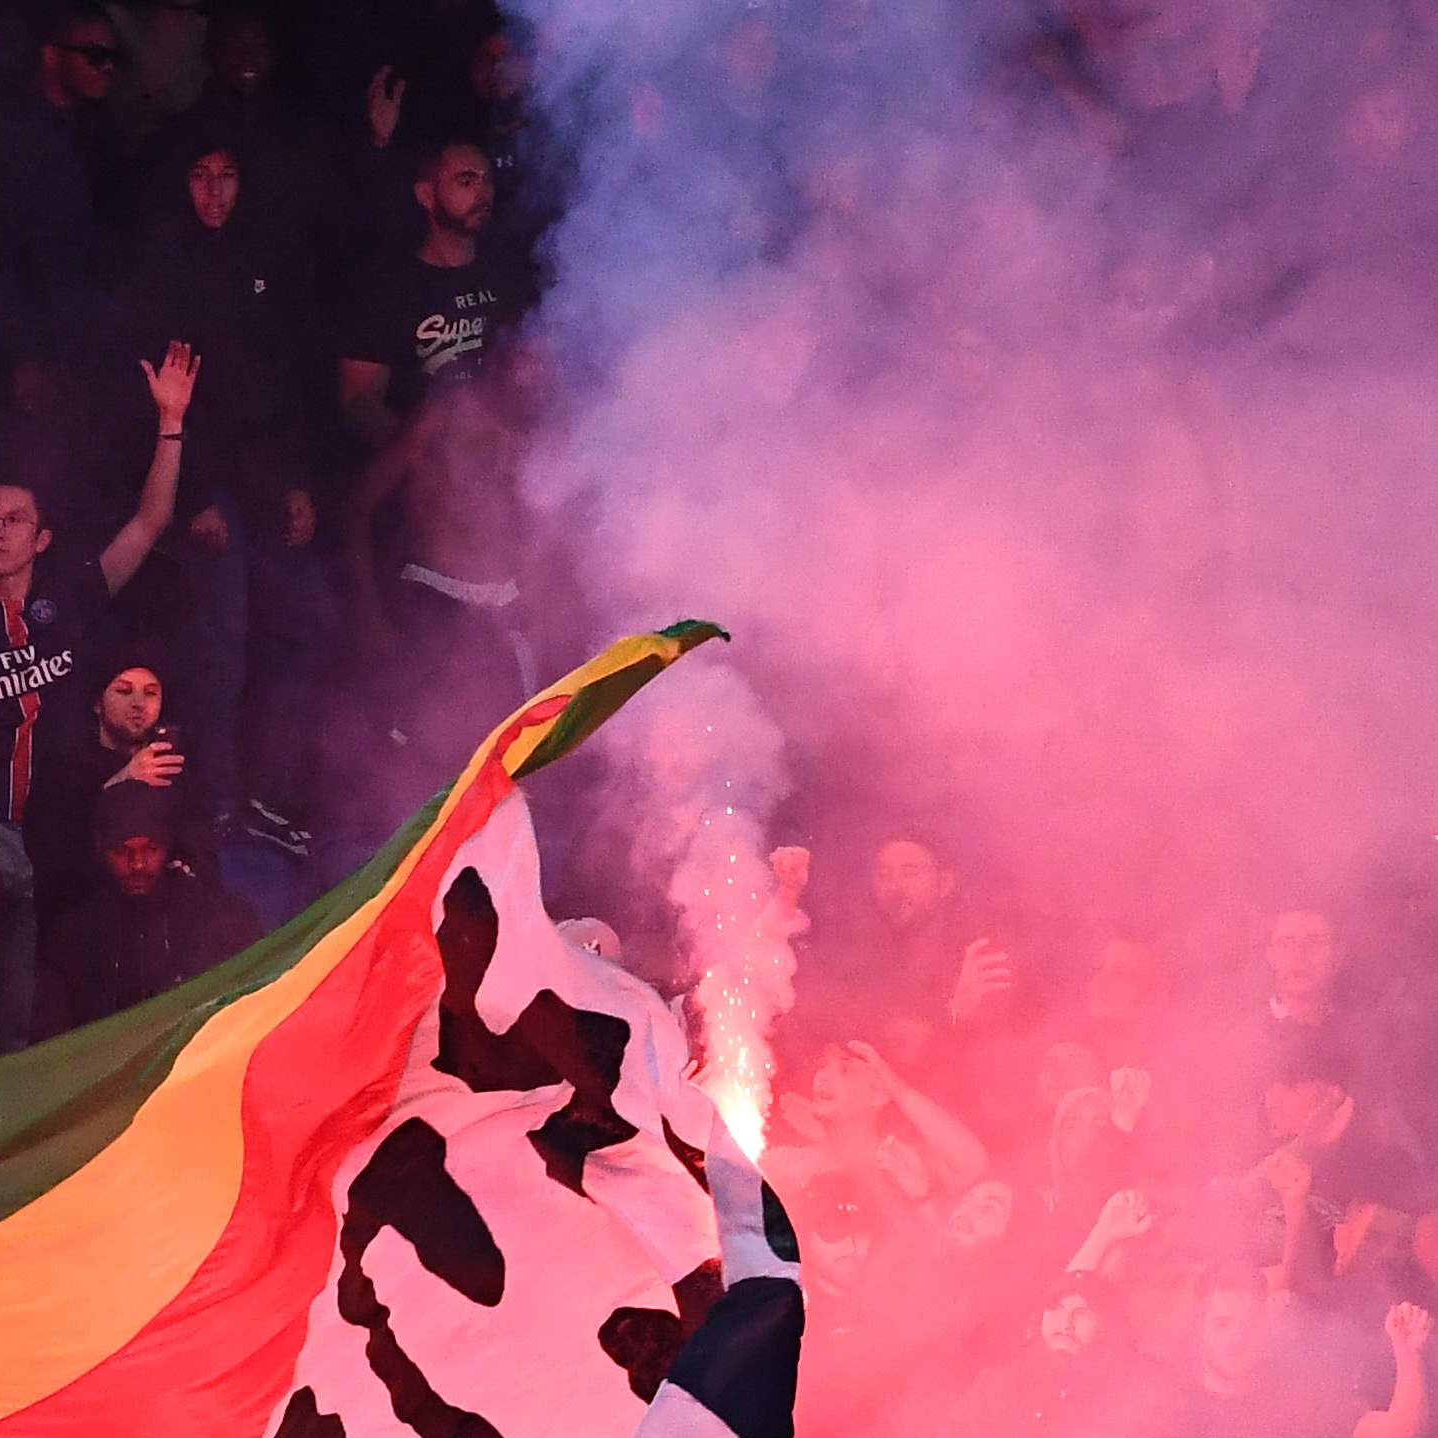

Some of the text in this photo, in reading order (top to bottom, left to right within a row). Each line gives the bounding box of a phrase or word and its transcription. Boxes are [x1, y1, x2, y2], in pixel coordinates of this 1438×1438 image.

[455, 289, 498, 310] REAL
[415, 314, 485, 358] Supe
[0, 645, 36, 670] Fly
